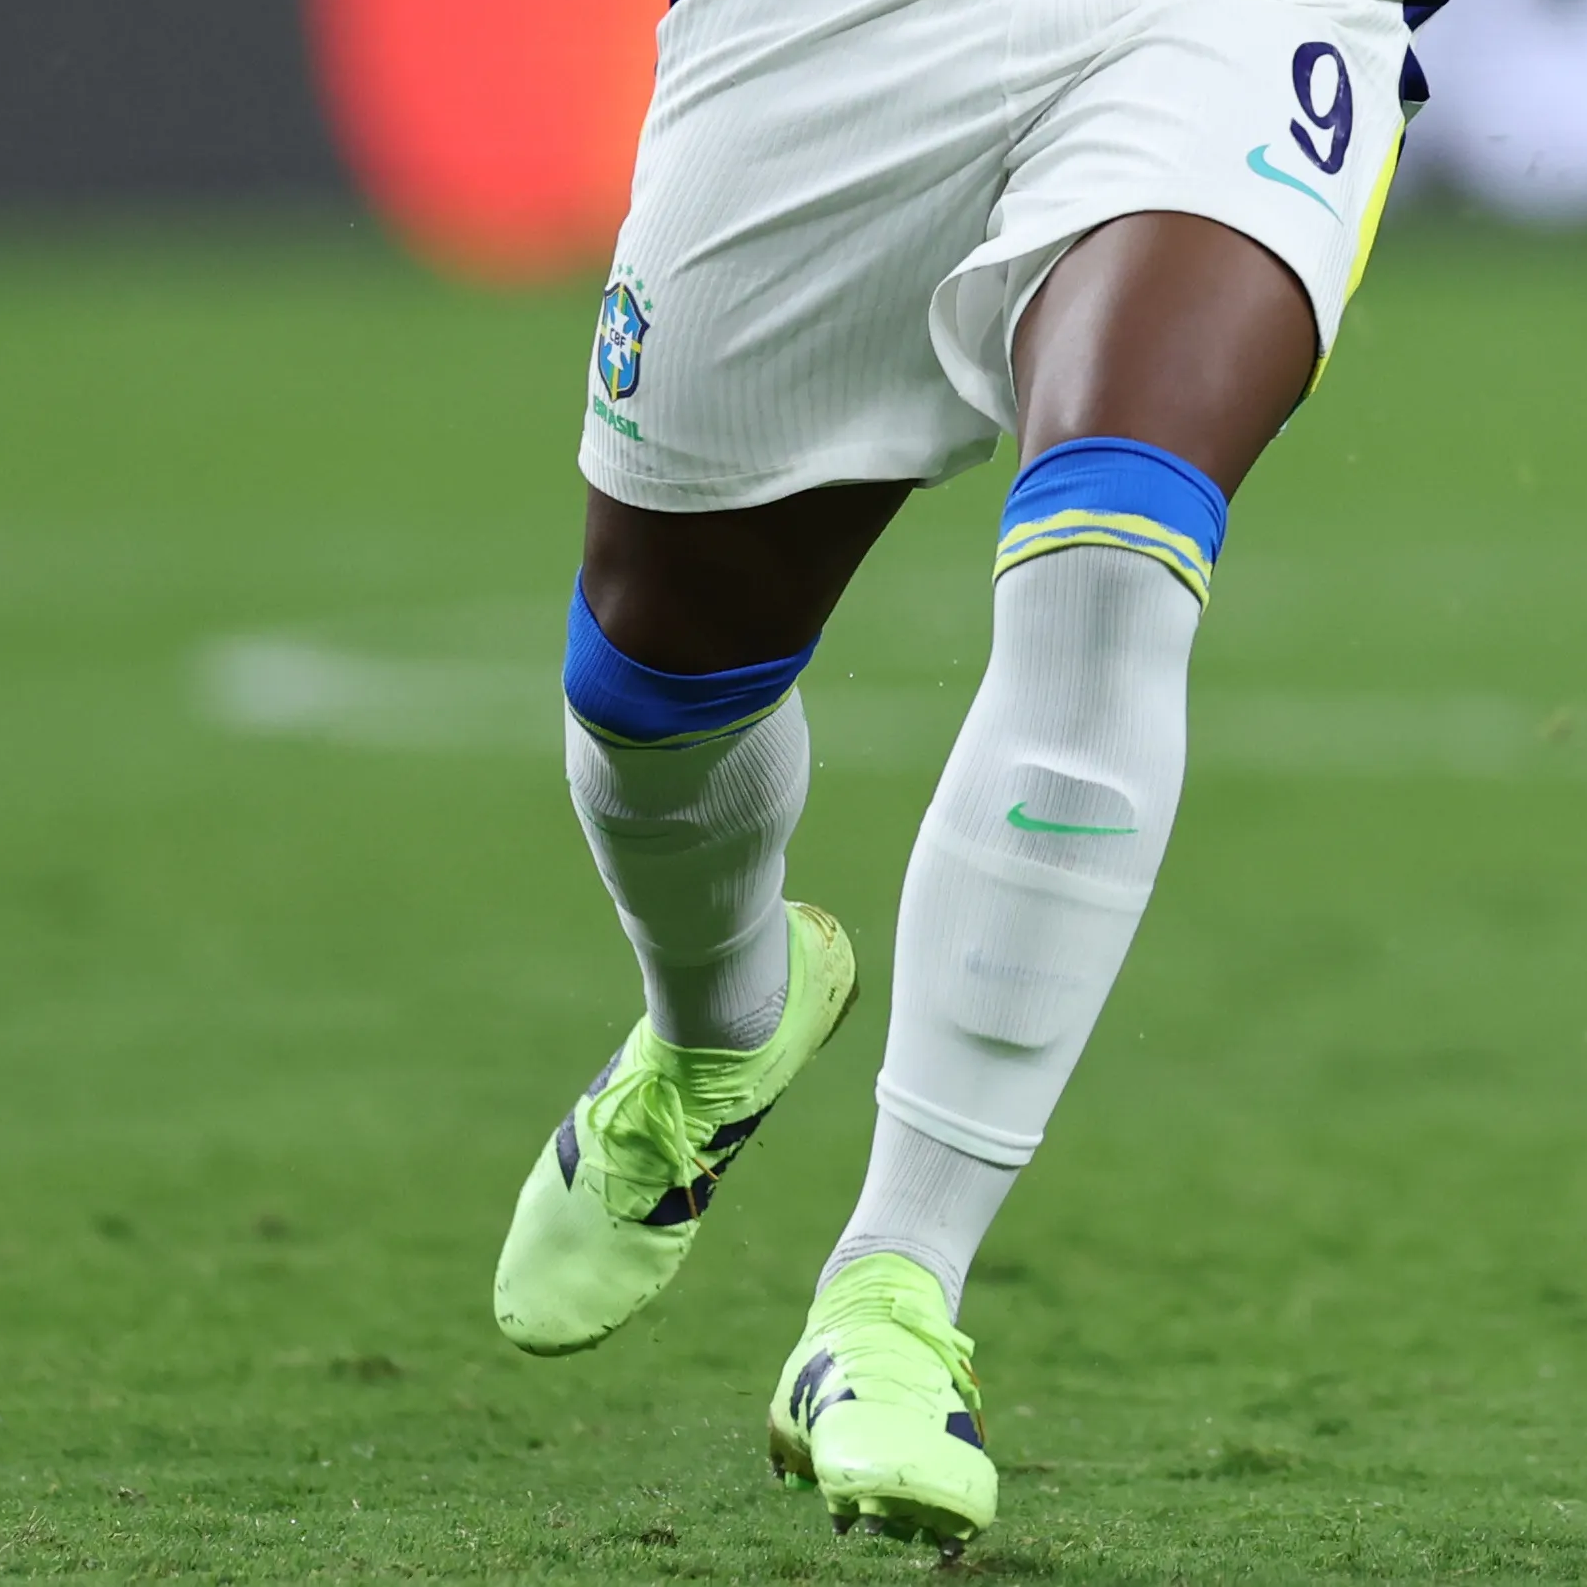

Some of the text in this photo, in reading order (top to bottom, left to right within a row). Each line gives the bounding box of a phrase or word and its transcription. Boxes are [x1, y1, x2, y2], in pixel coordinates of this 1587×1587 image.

[1290, 41, 1353, 174] 9
[610, 328, 626, 348] CBF
[594, 395, 644, 441] BRASIL
